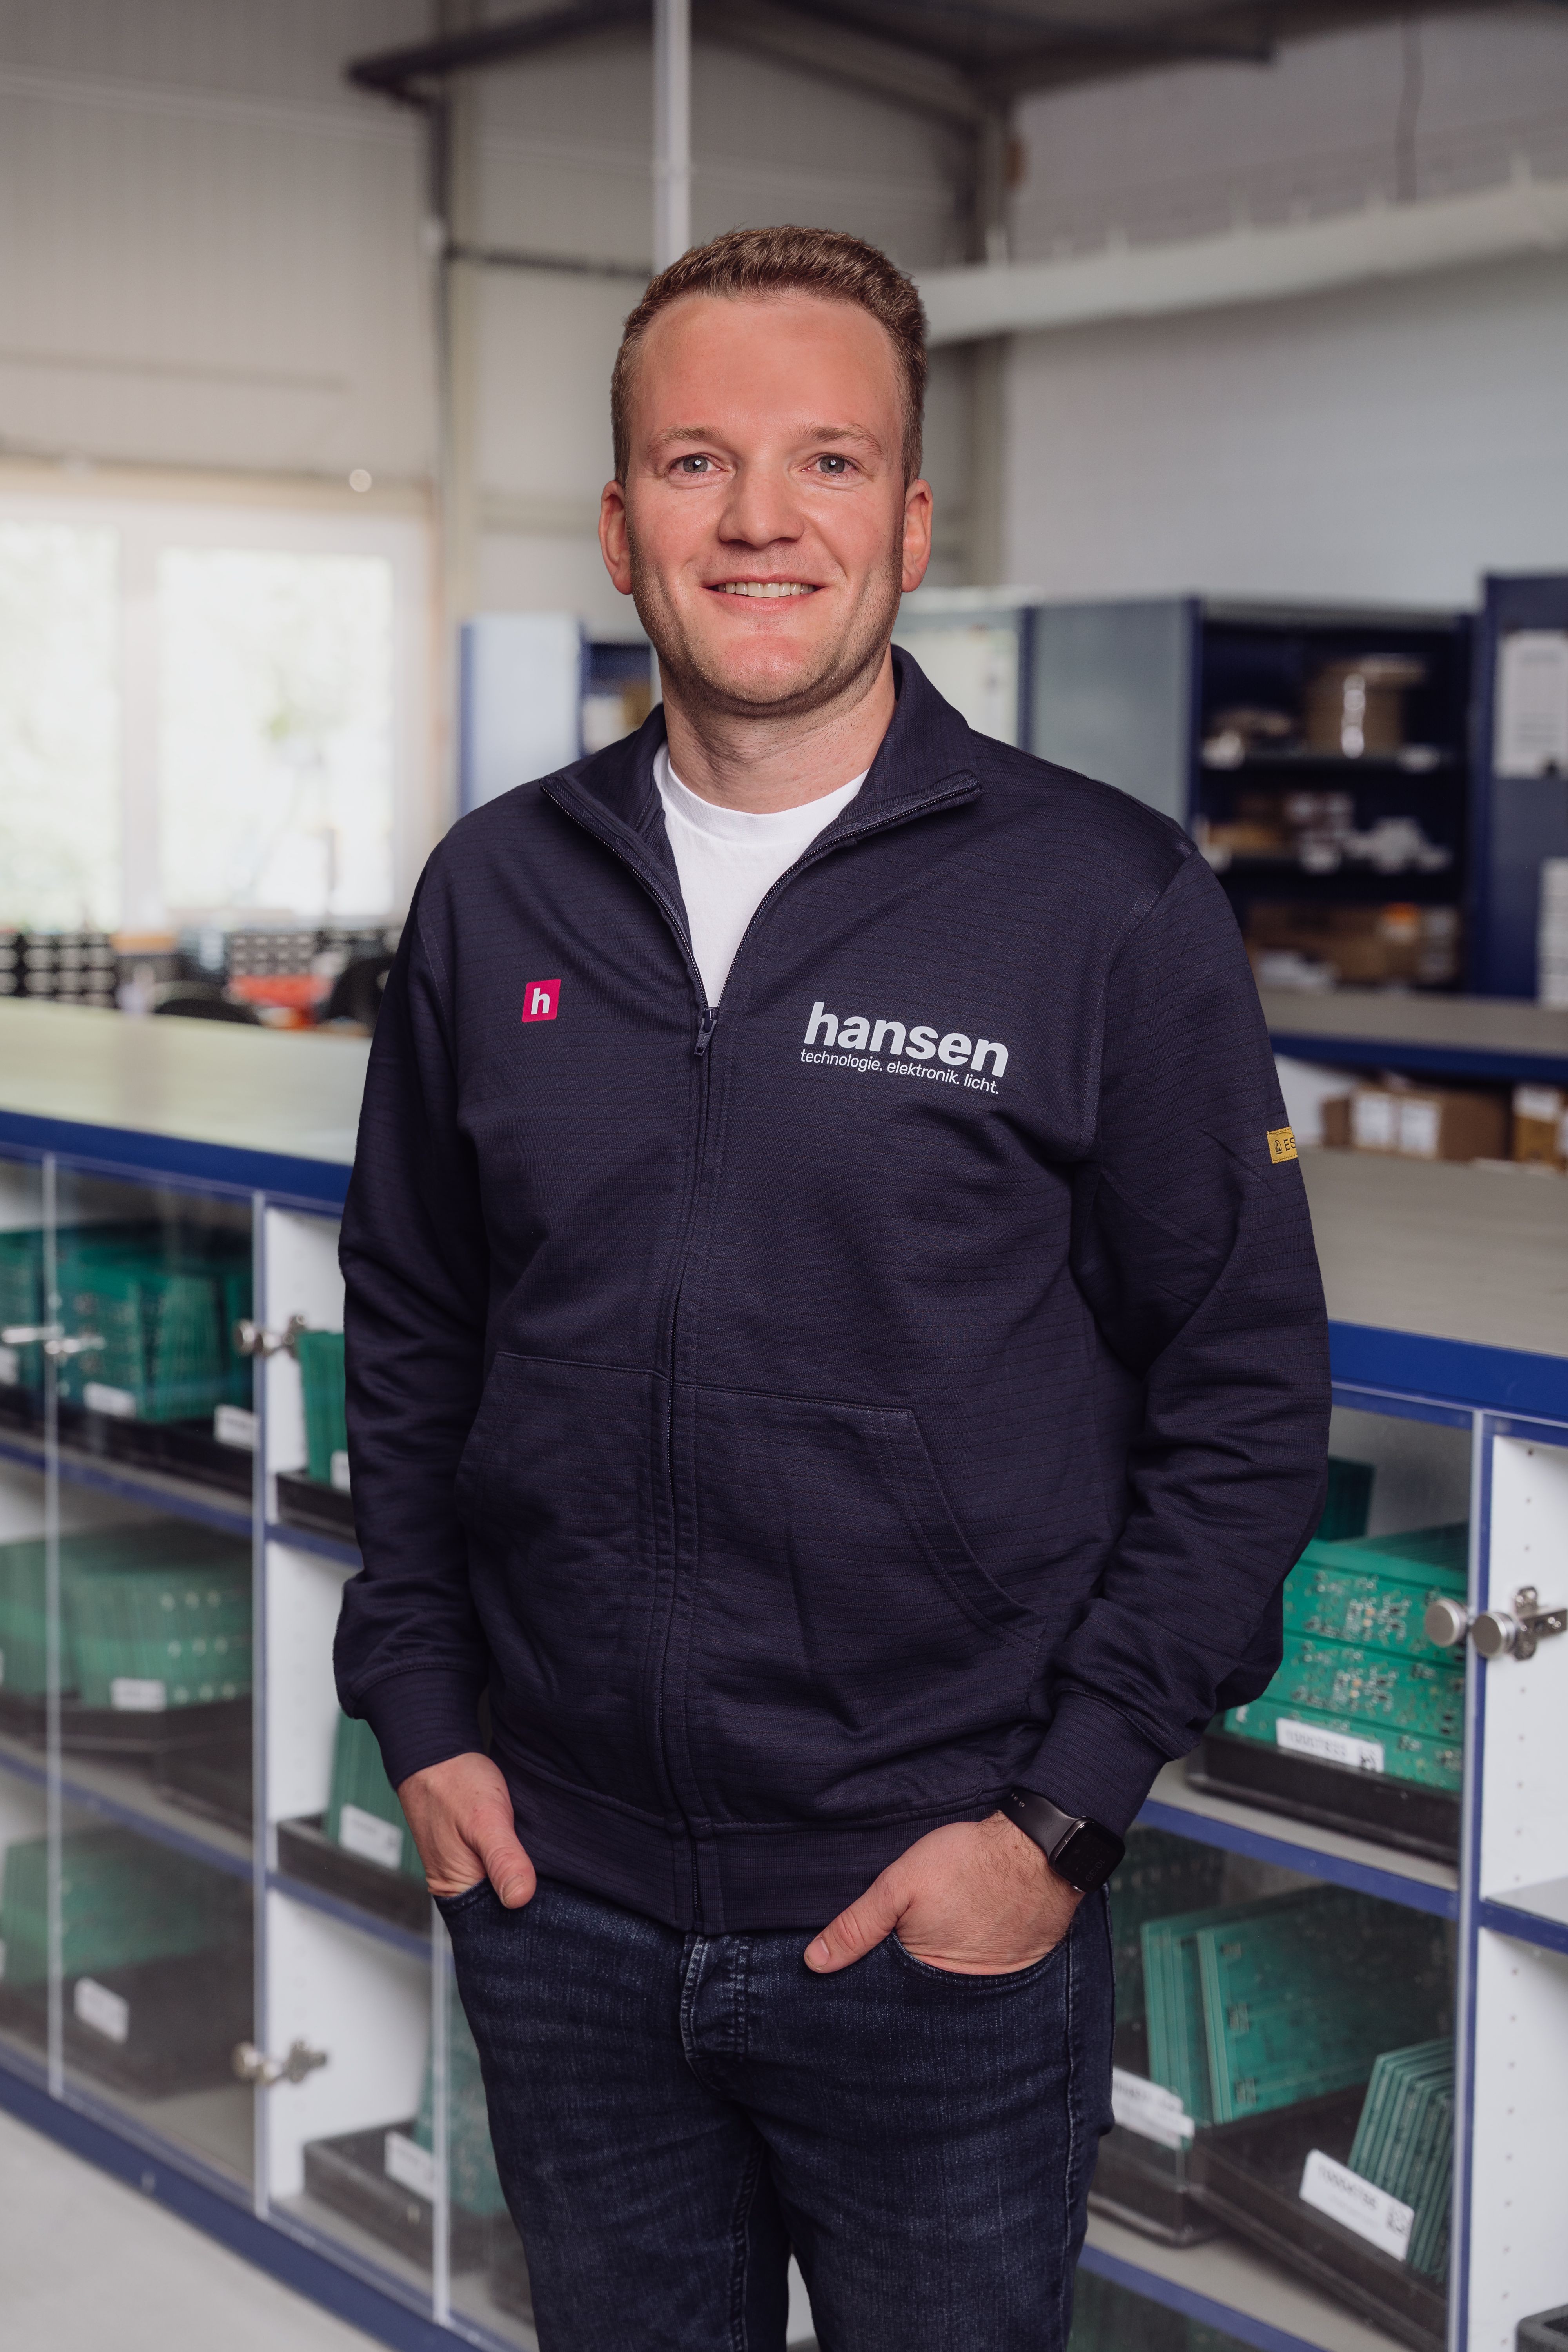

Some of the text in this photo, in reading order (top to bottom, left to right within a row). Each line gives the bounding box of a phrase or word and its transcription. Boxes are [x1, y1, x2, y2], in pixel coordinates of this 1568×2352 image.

[530, 987, 550, 1015] h
[804, 1001, 1009, 1078] hansen
[800, 1049, 998, 1094] technologie. elektronik. licht.
[1085, 1859, 1105, 1882] 10:39
